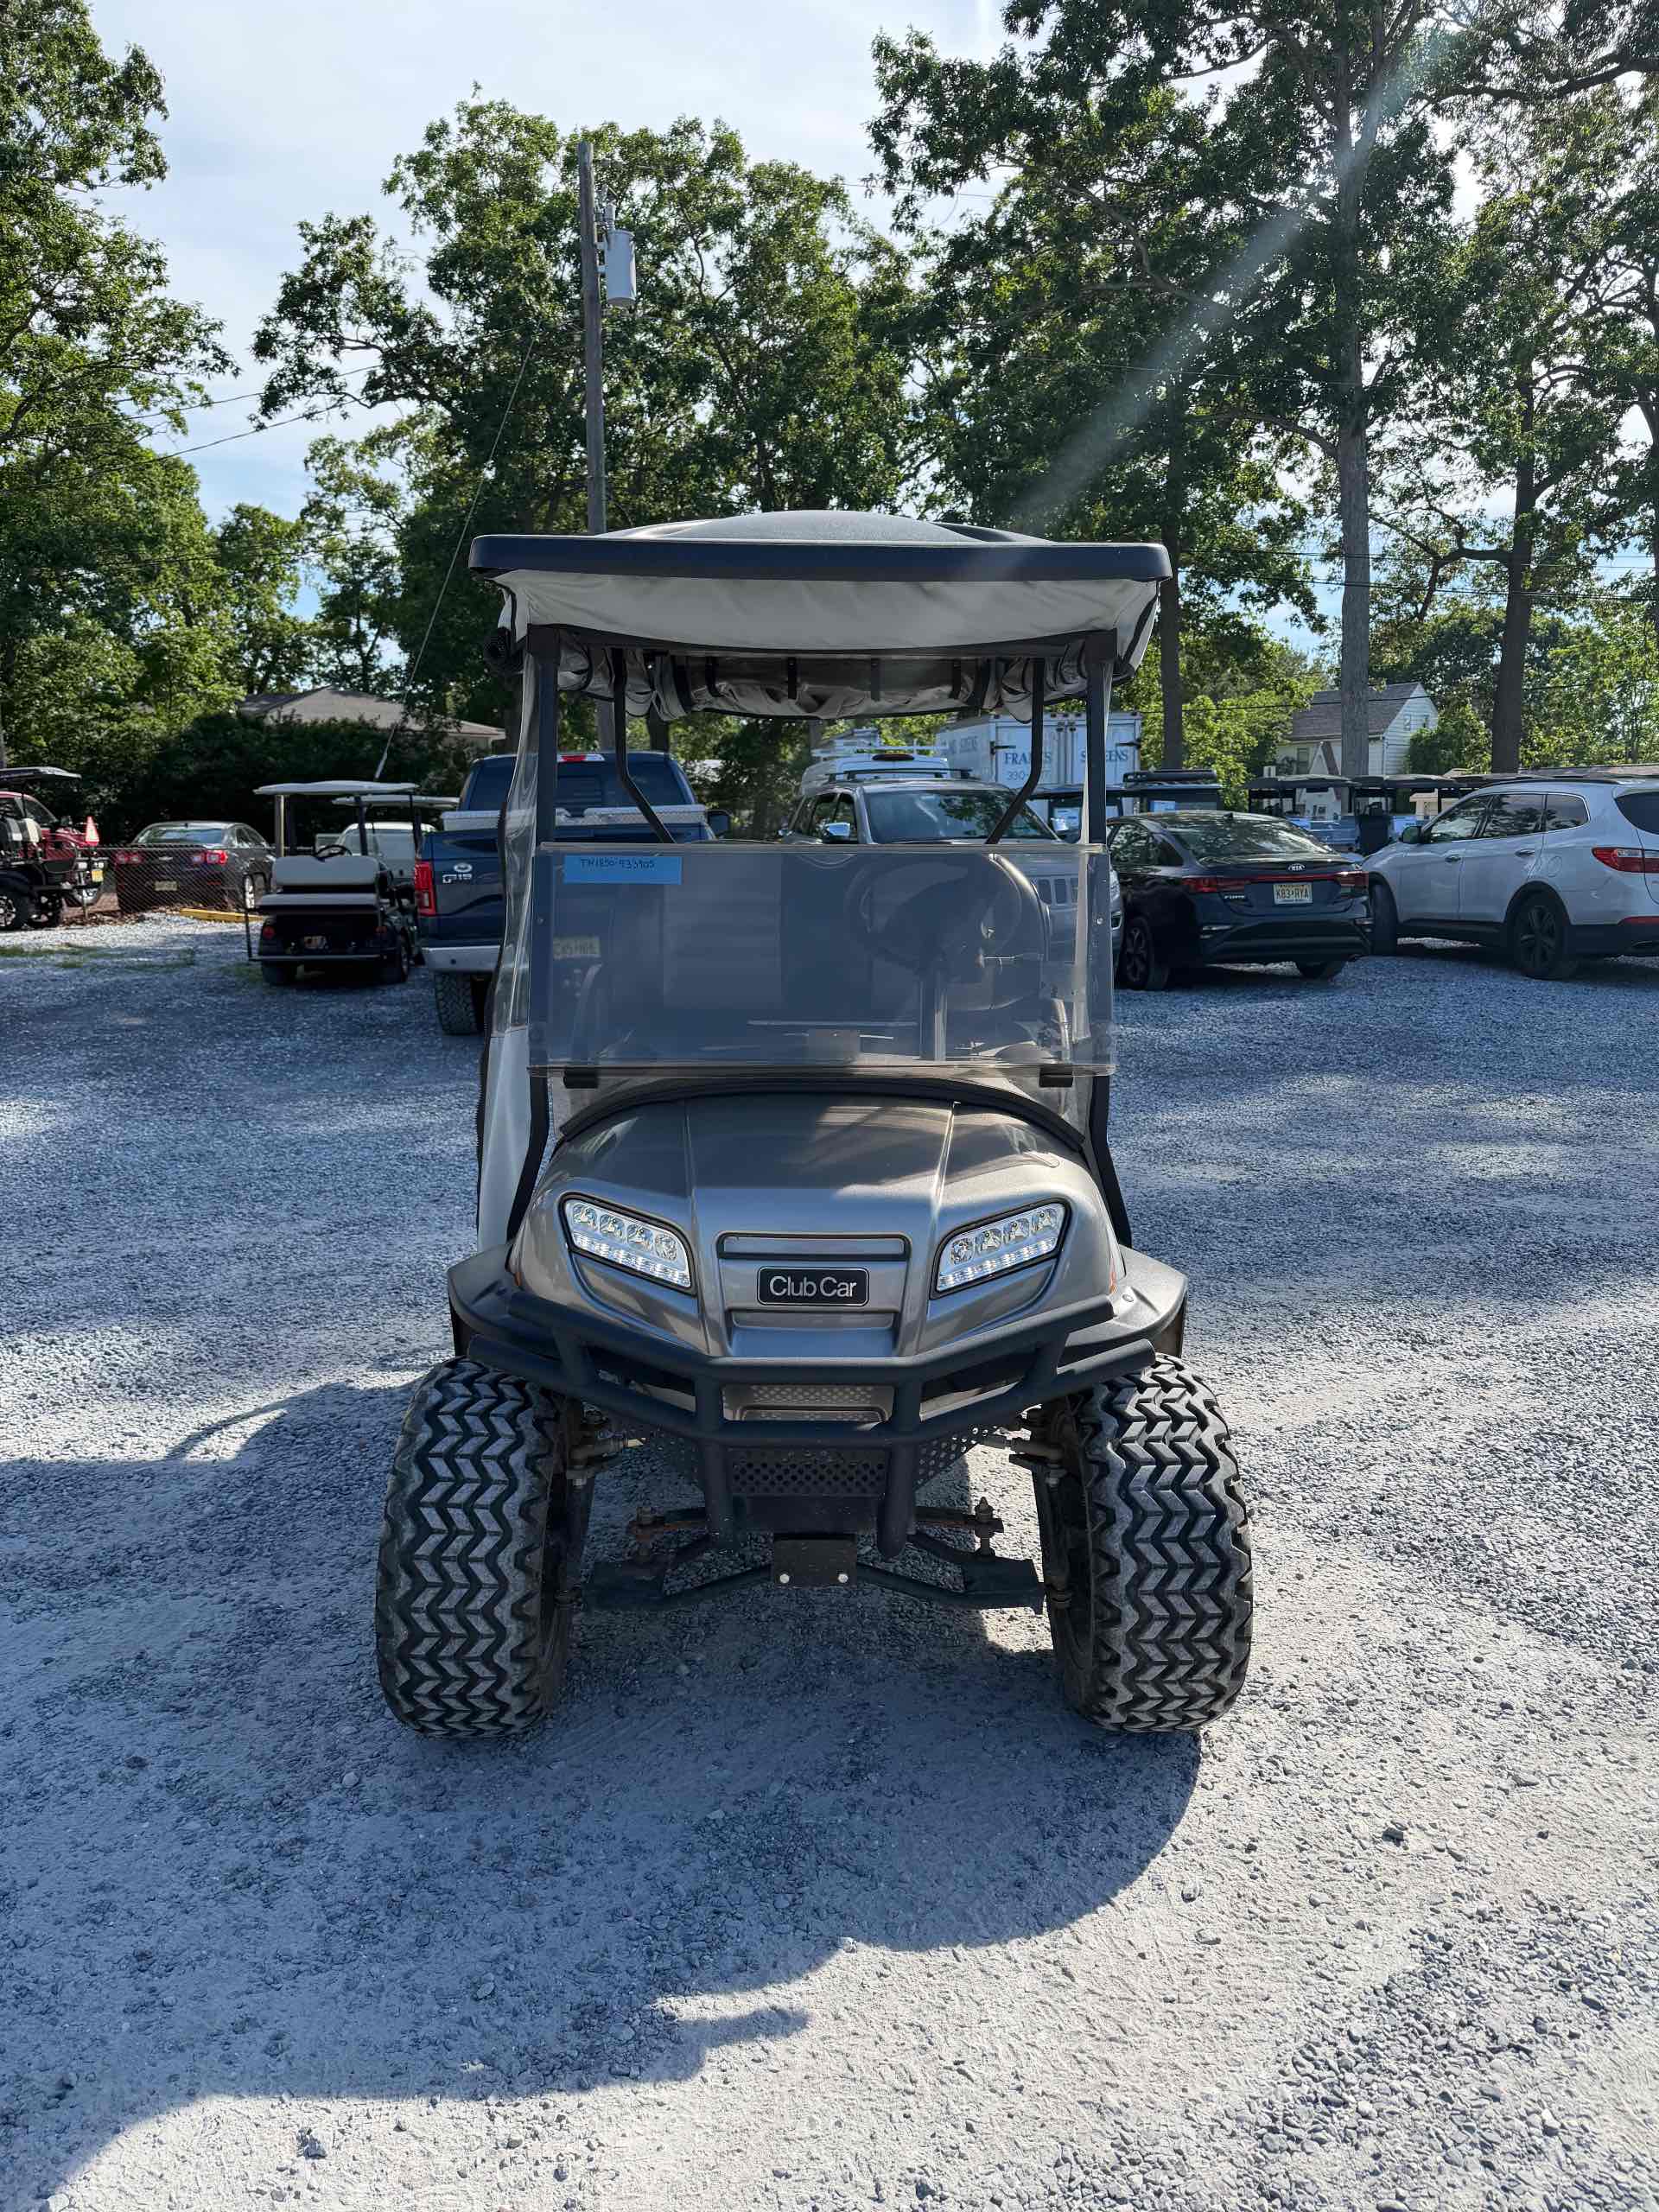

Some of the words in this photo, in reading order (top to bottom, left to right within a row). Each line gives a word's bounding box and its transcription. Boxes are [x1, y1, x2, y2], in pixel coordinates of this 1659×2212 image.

[1004, 752, 1052, 764] FRAS
[1080, 750, 1128, 761] SENS
[769, 1275, 817, 1296] Club
[819, 1276, 857, 1297] Car
